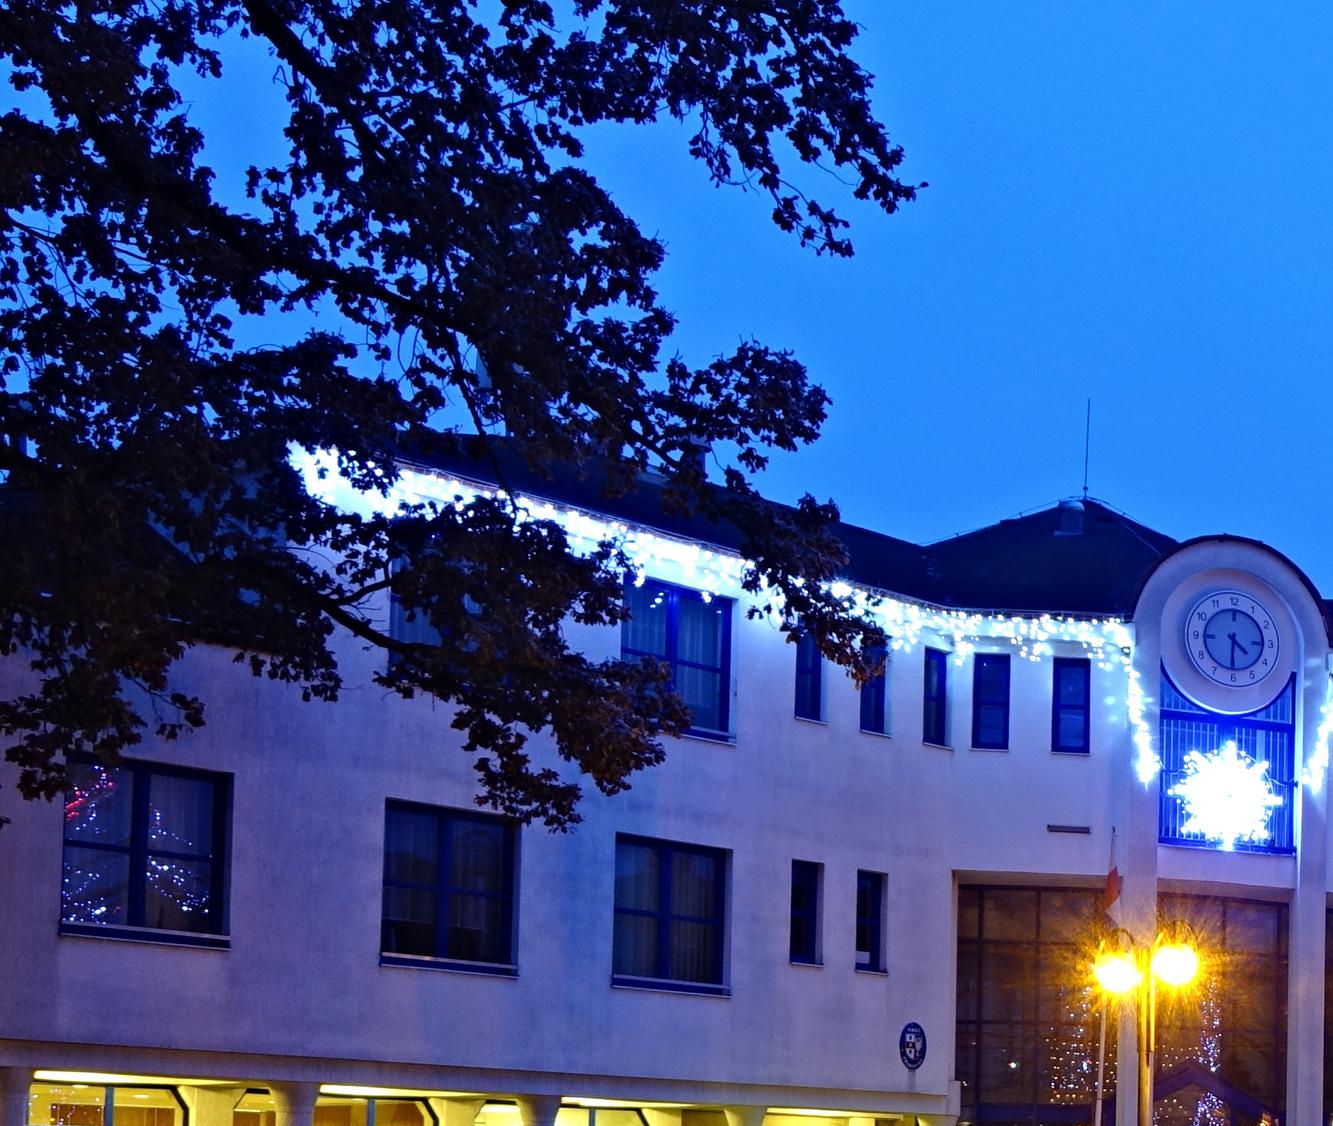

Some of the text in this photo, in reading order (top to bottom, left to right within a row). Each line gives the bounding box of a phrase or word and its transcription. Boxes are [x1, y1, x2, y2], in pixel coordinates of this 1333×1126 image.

[1211, 599, 1219, 608] 11
[1229, 597, 1239, 606] 12
[1197, 612, 1207, 621] 10
